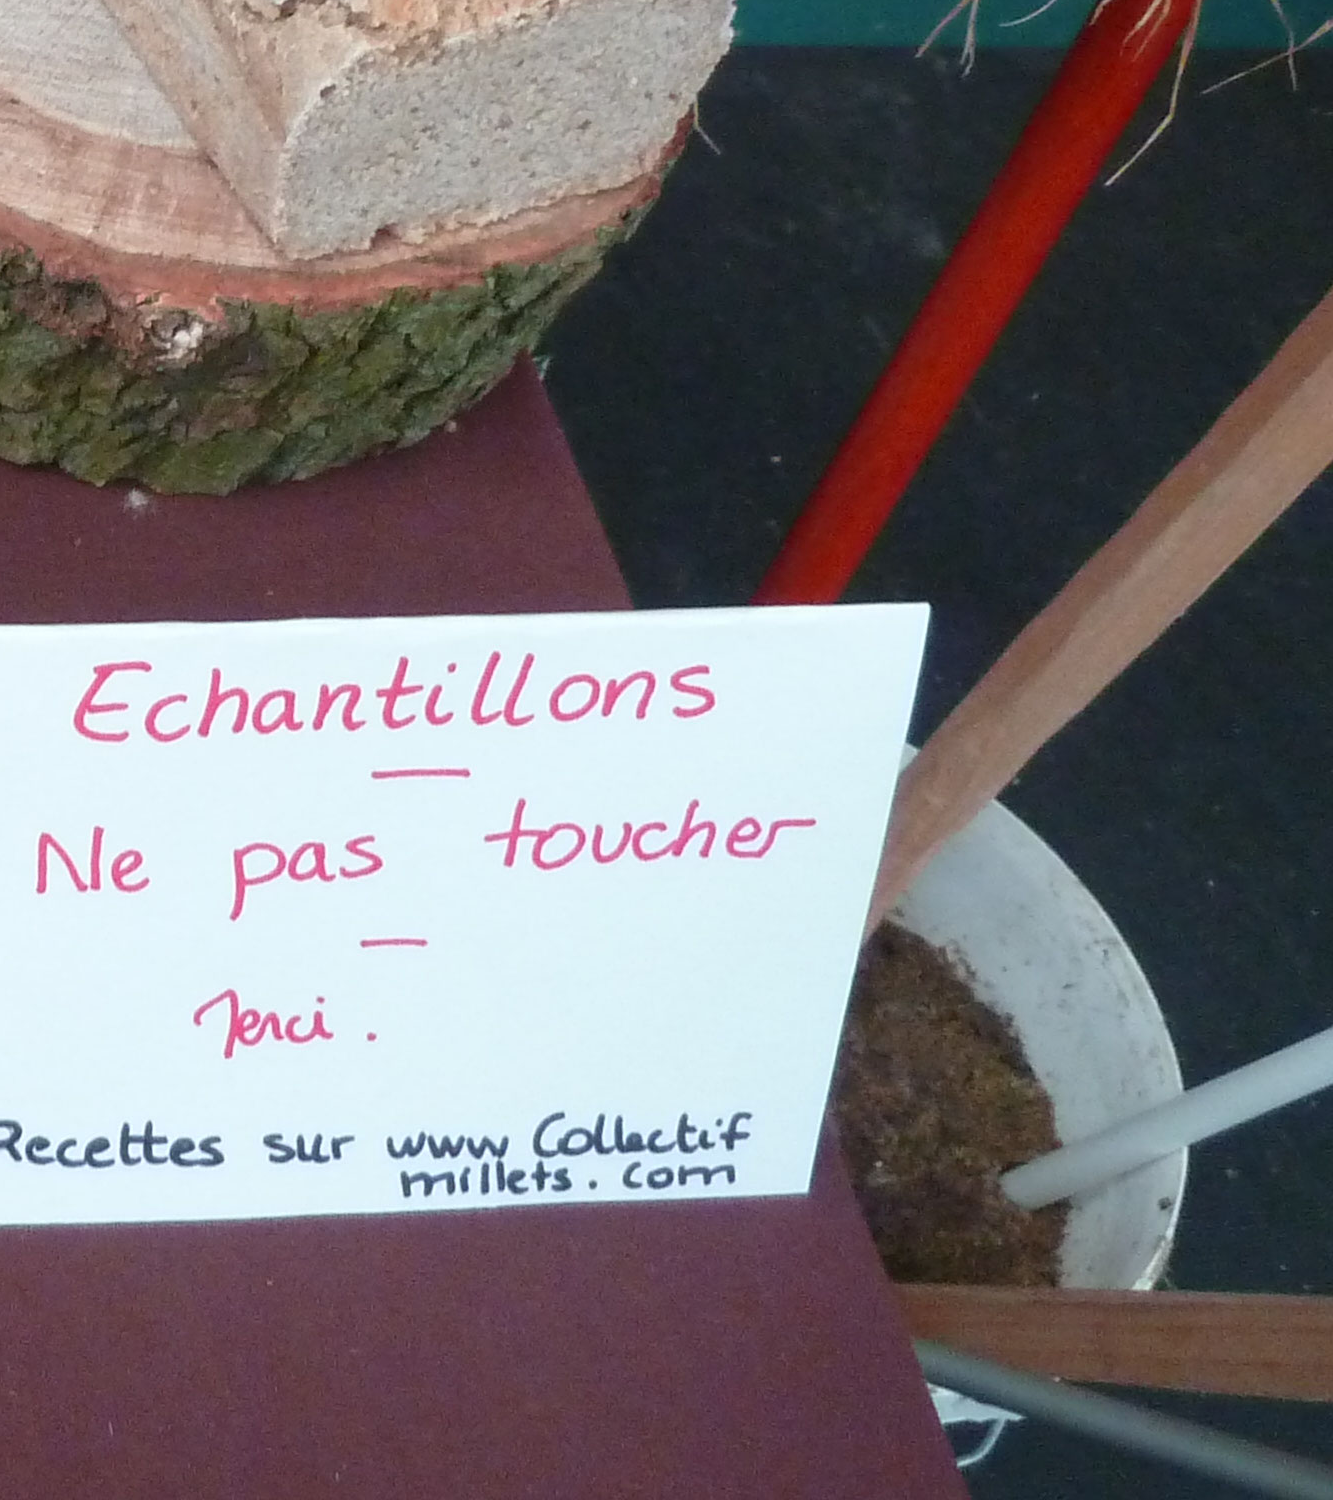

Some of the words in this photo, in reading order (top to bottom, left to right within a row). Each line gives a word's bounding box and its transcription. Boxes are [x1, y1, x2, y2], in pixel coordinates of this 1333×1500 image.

[73, 652, 718, 745] Echantillons
[35, 826, 150, 896] Ne
[229, 829, 386, 921] pas
[484, 798, 817, 871] toucher
[267, 1129, 355, 1164] sur
